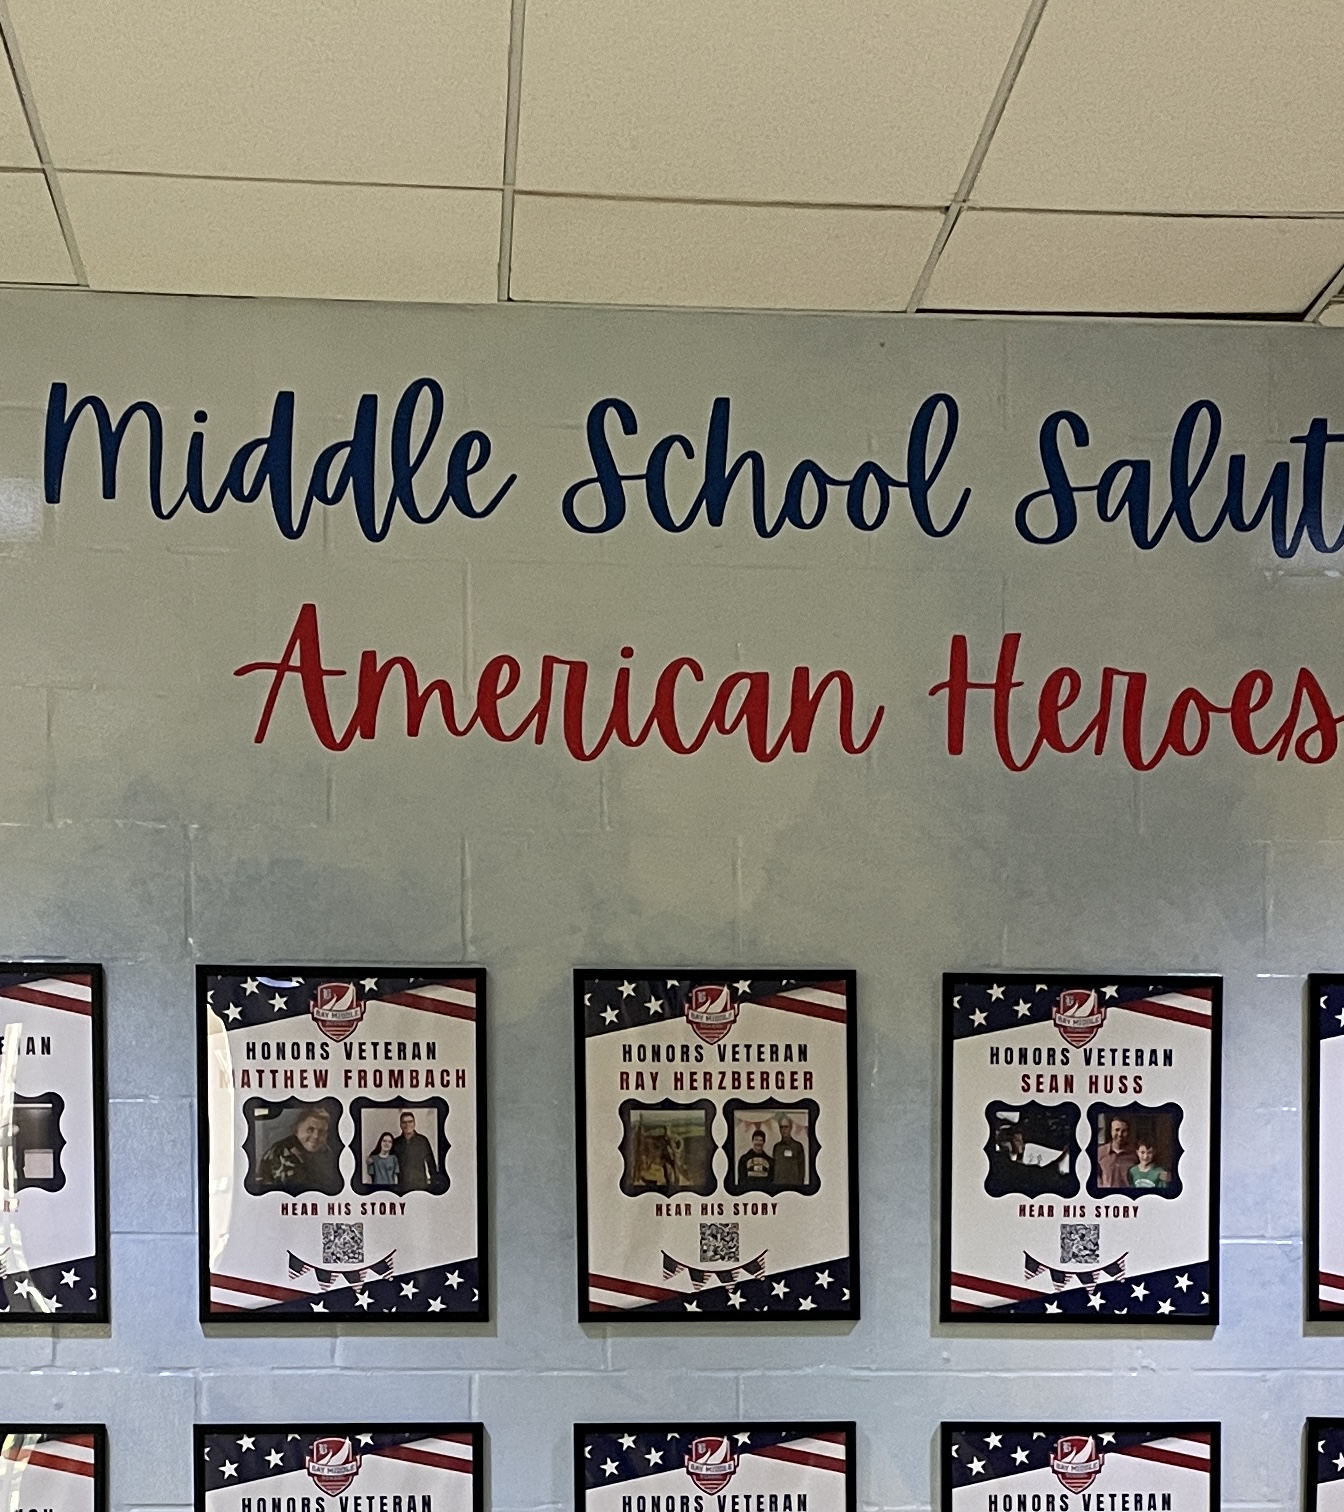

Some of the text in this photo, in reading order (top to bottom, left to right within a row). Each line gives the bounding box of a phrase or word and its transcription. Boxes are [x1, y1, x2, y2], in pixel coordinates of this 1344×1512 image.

[44, 378, 517, 542] Middle
[562, 393, 971, 537] School
[233, 603, 885, 762] American
[247, 1042, 436, 1060] HONORS VETERAN
[623, 1044, 807, 1062] HONORS VETERAN
[990, 1047, 1172, 1067] HONORS VETERAN
[344, 1069, 465, 1088] FROMBACH
[620, 1071, 813, 1090] RAY HERZBERGER
[1022, 1074, 1142, 1093] SEAN HUSS
[282, 1202, 405, 1215] HEAR HIS STORY
[656, 1203, 777, 1216] HEAR HIS STORY
[1019, 1205, 1138, 1218] HEAR HIS STORY
[623, 1494, 806, 1512] HONORS VETERAN
[989, 1493, 1171, 1512] HONORS VETERAN
